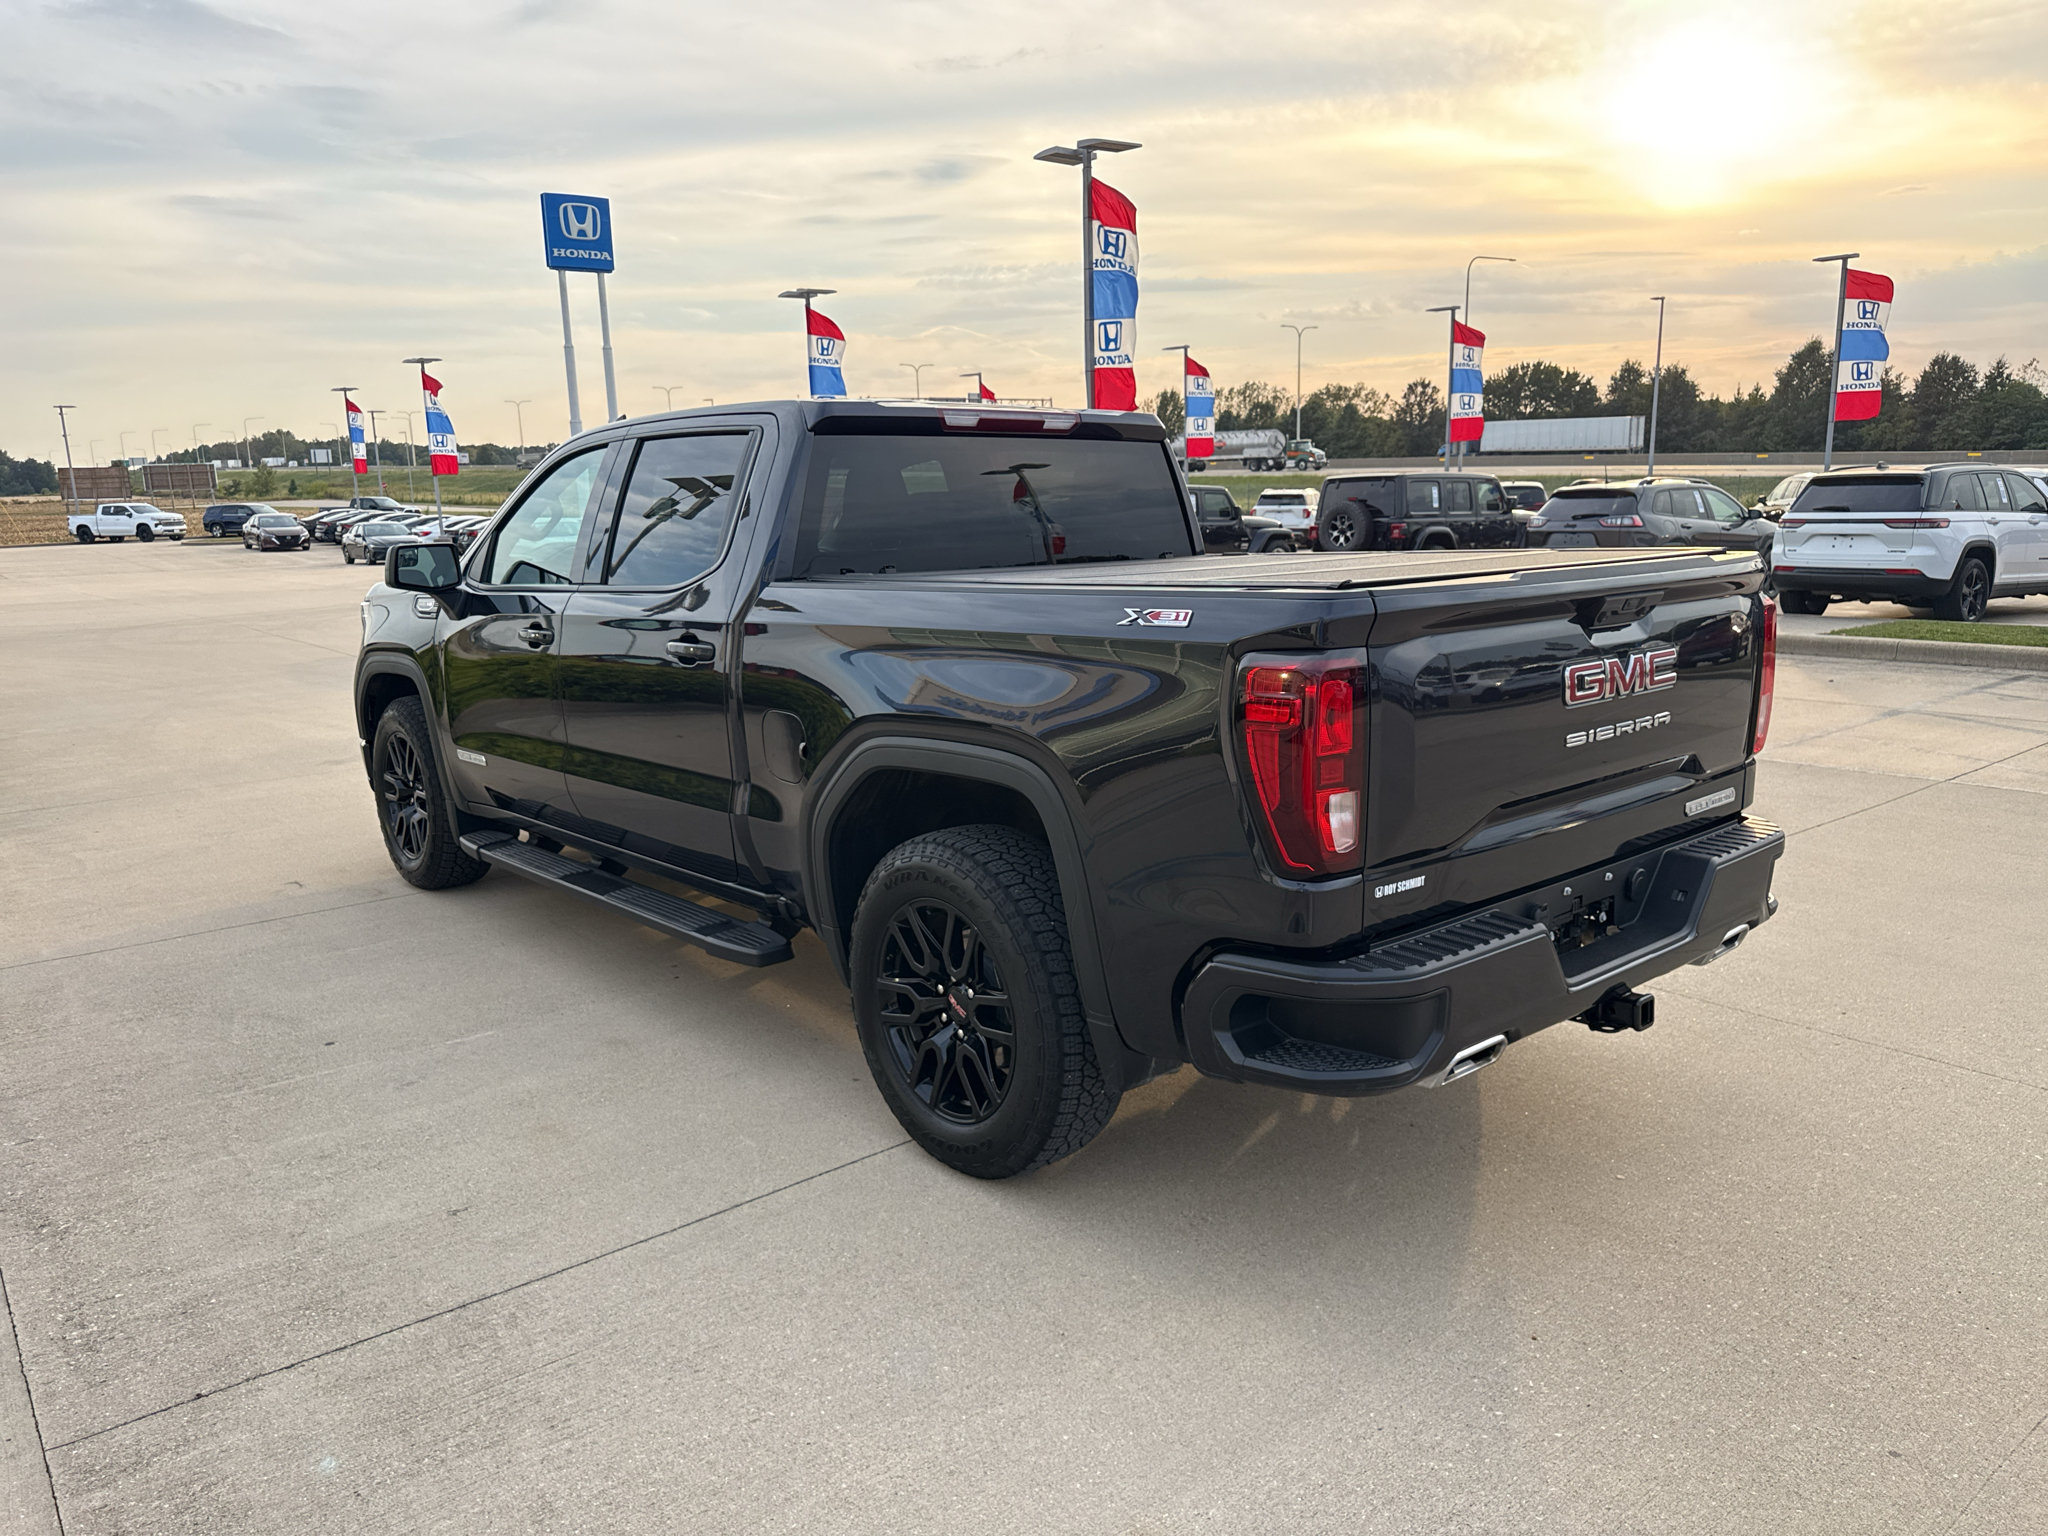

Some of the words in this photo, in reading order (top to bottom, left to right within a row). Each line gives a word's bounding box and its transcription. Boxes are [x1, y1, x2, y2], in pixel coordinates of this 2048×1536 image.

[552, 248, 612, 260] HONDA
[1093, 258, 1136, 275] HONDA
[1840, 383, 1881, 391] HONDA
[1565, 648, 1677, 706] GMC
[1566, 711, 1671, 748] SIERRA
[1384, 882, 1397, 896] ROY
[1397, 875, 1426, 893] SCHMIDT
